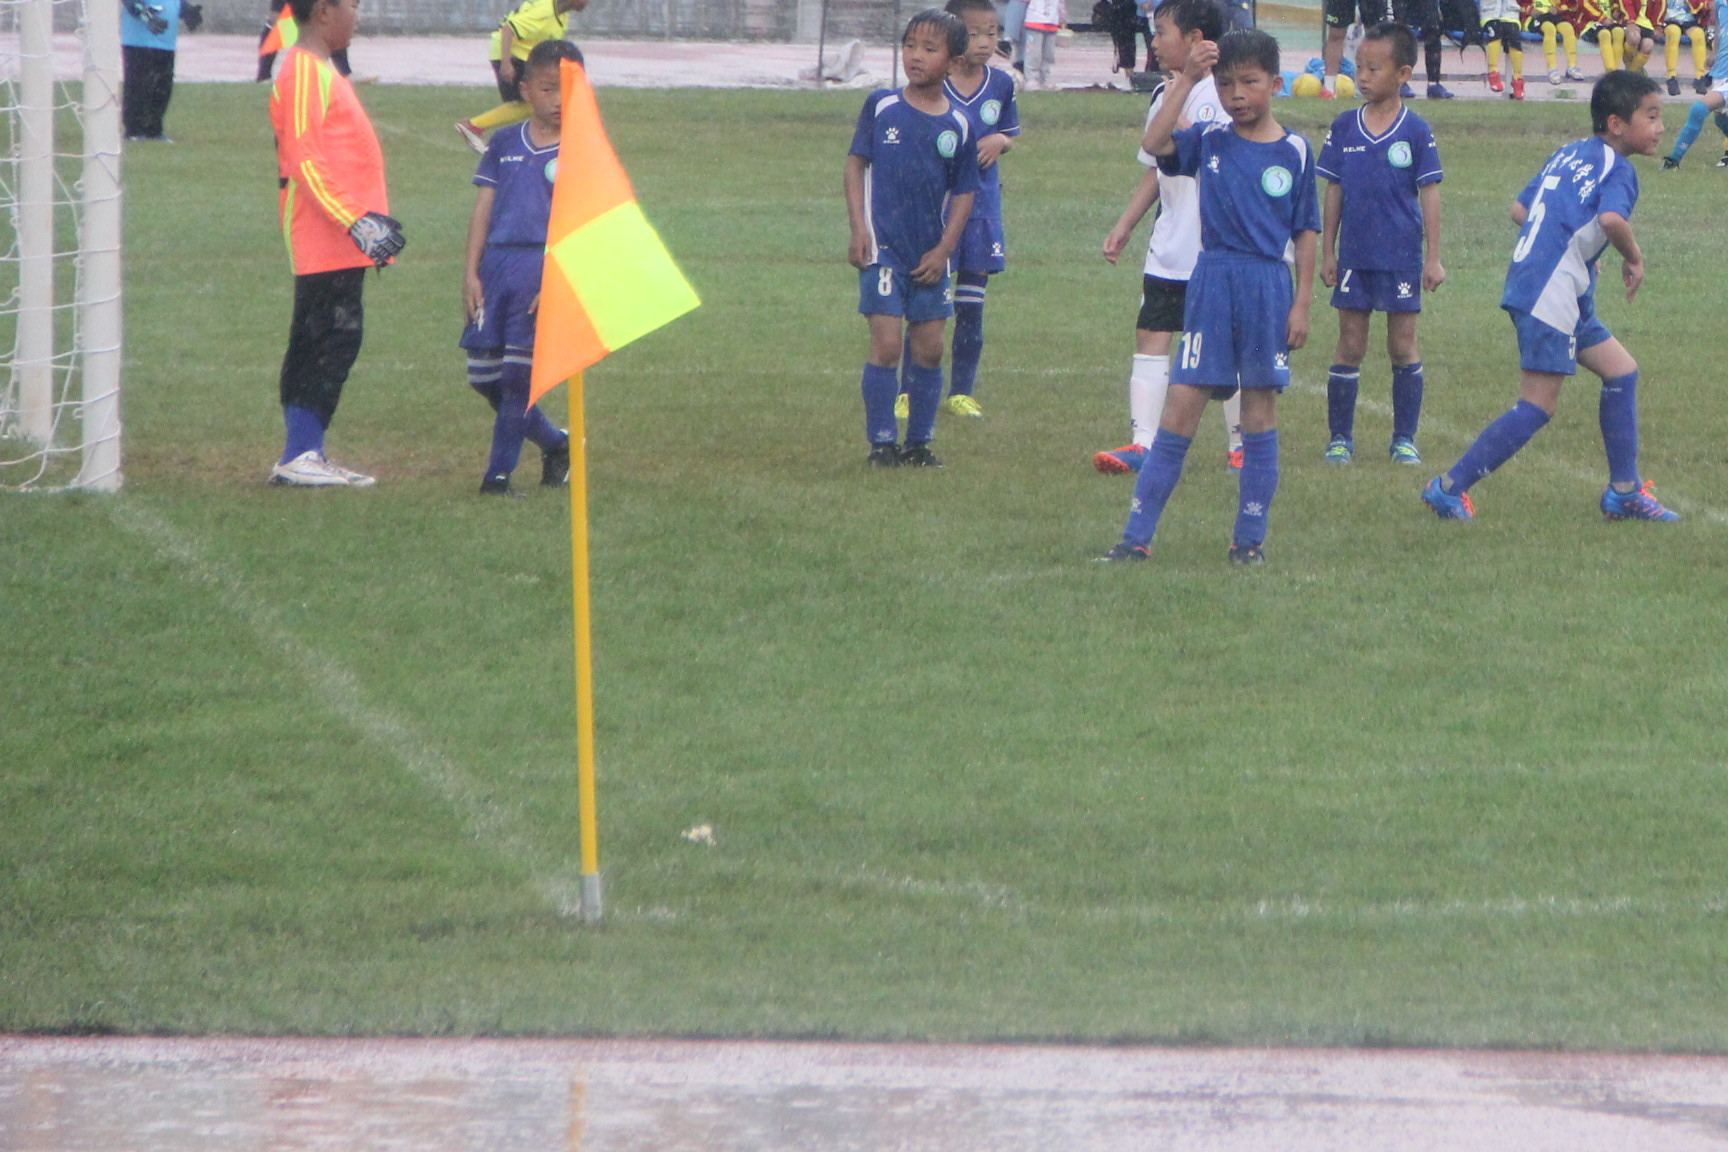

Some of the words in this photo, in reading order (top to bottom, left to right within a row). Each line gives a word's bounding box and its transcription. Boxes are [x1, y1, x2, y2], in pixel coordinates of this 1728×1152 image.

[1343, 145, 1366, 153] KELME
[1513, 175, 1562, 263] 5
[877, 268, 893, 297] 8
[1181, 331, 1203, 370] 19
